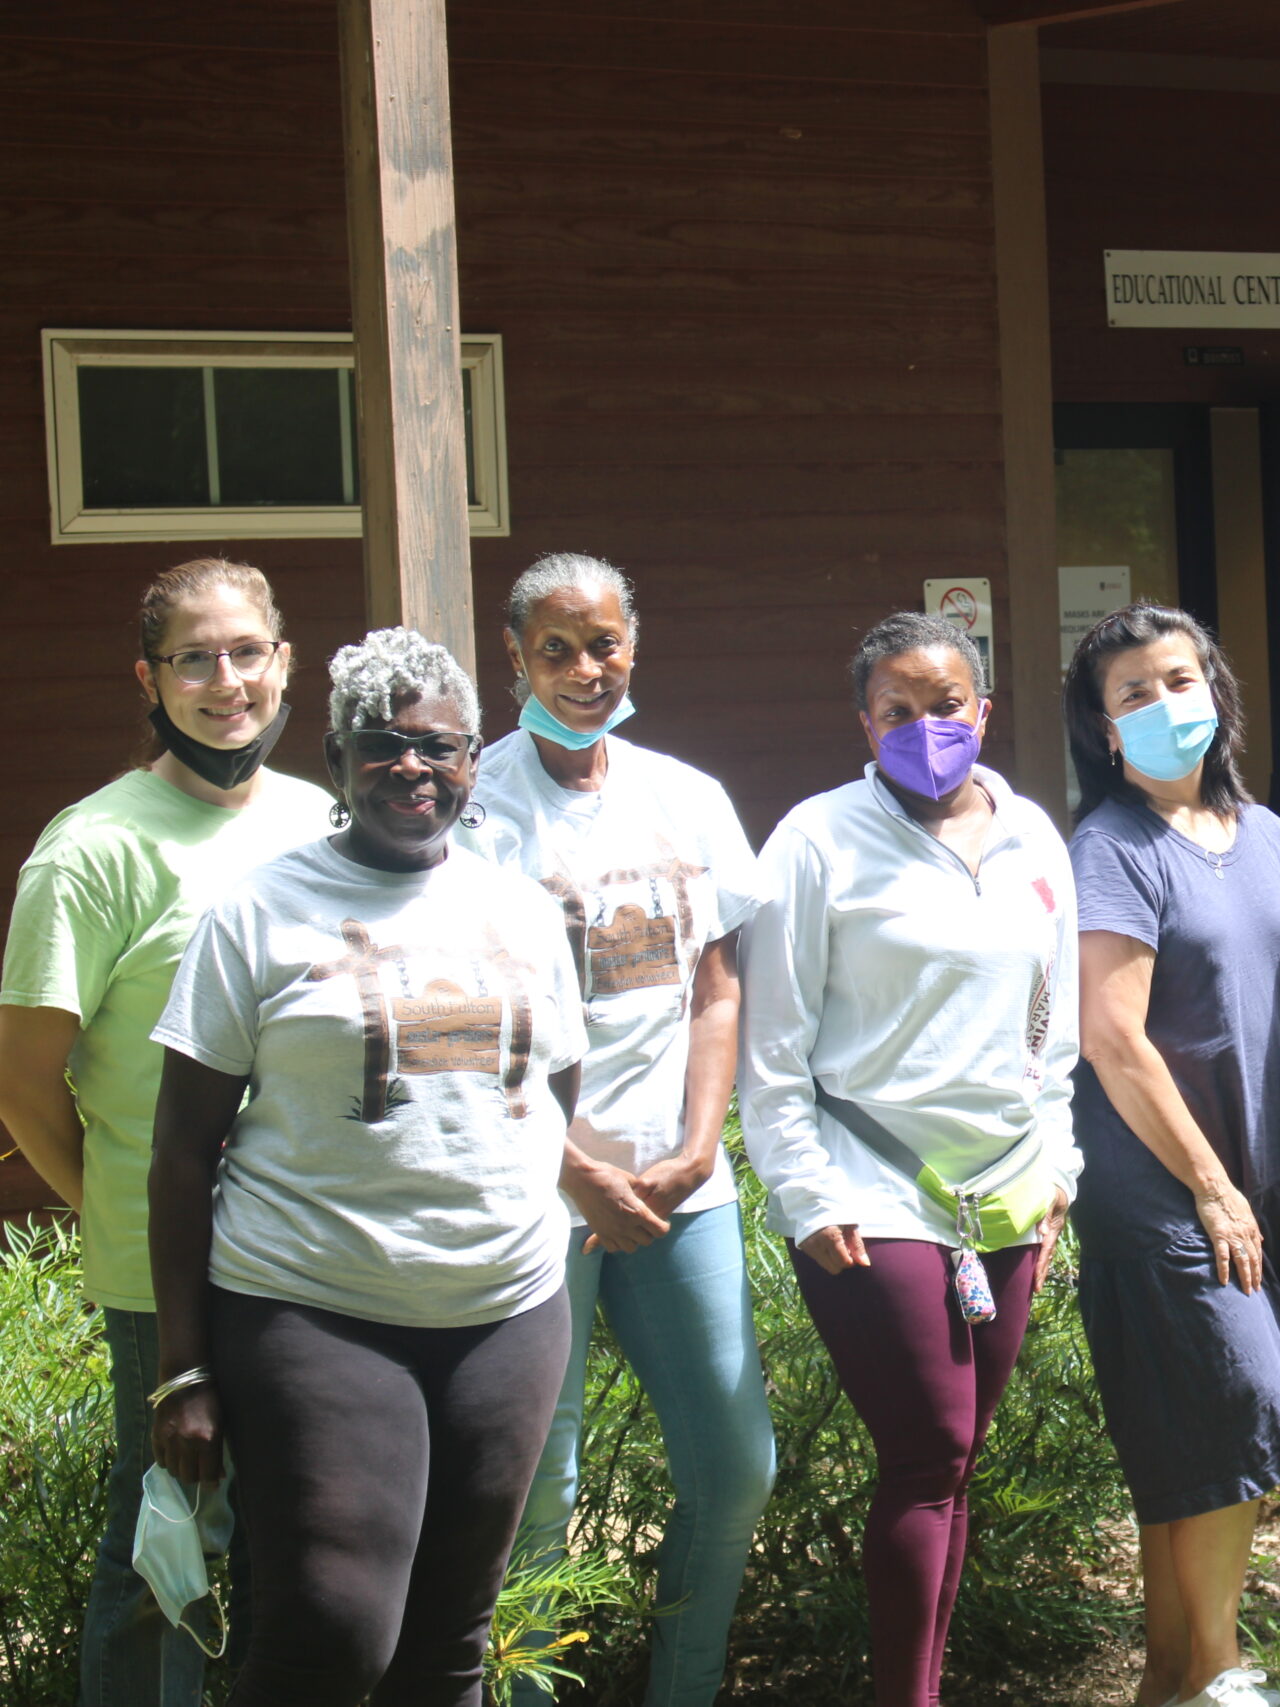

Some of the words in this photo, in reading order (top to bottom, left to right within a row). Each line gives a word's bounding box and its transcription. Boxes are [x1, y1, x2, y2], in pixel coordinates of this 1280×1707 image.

[1112, 274, 1226, 305] EDUCATIONAL
[1064, 610, 1090, 618] MASKS
[402, 997, 446, 1016] South
[448, 996, 496, 1014] Fulton
